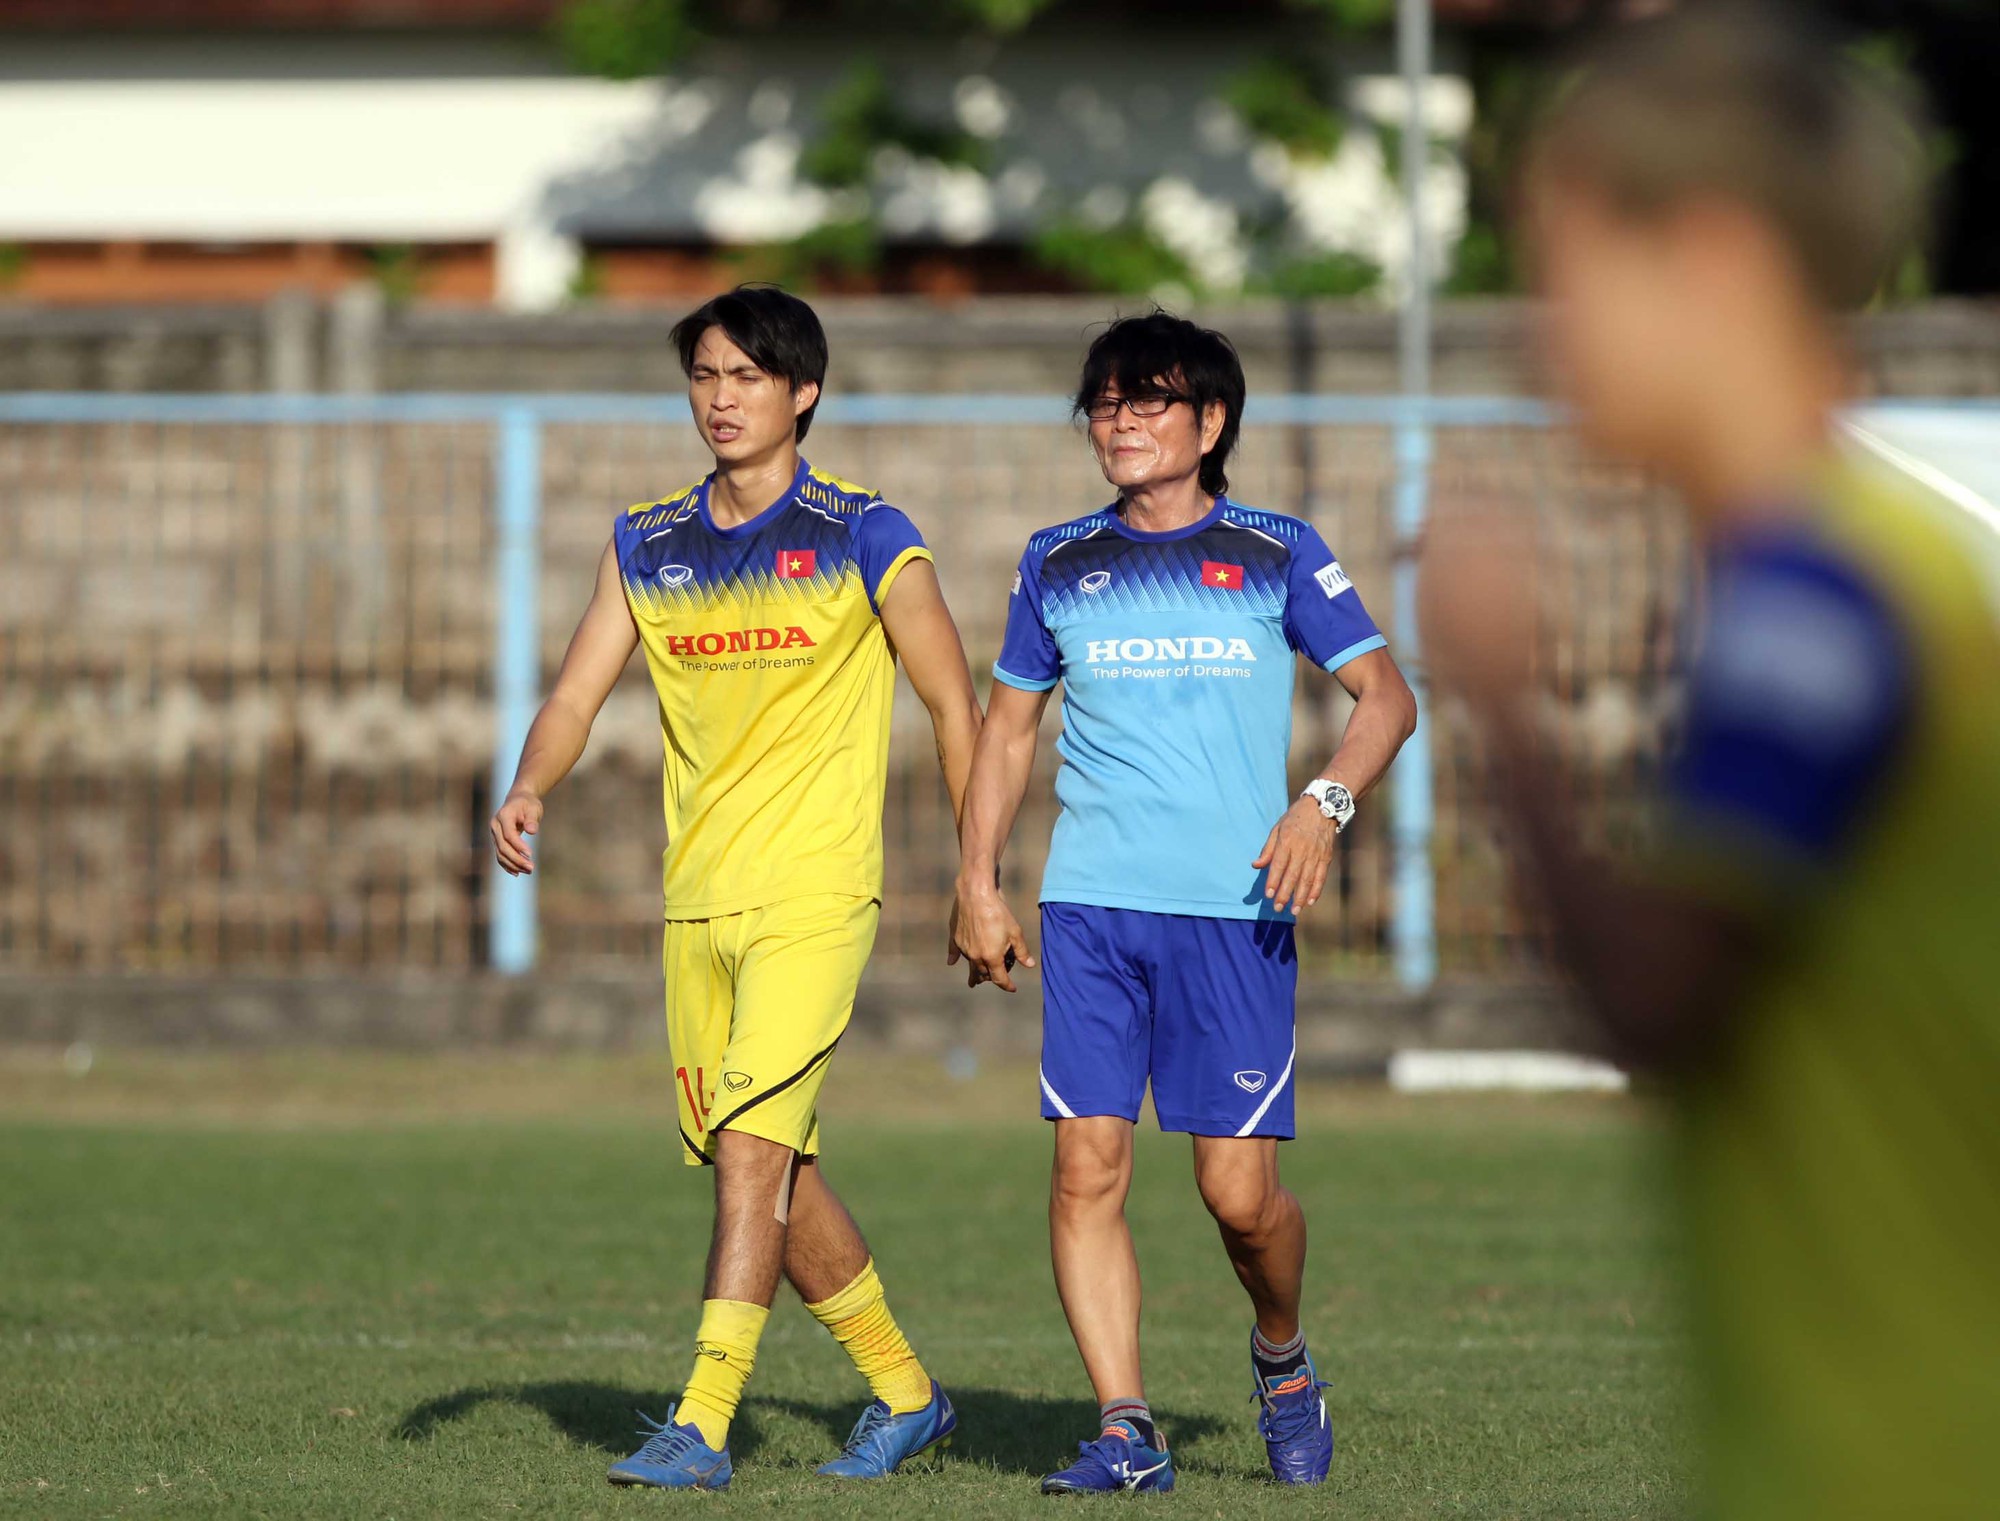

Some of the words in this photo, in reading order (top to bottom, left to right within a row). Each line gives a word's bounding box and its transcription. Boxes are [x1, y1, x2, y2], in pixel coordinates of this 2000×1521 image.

[666, 626, 817, 656] HONDA
[1085, 636, 1257, 663] HONDA
[679, 660, 702, 671] The
[704, 661, 741, 672] Power
[743, 658, 757, 670] of
[760, 656, 815, 669] Dreams
[1091, 667, 1119, 679] The
[1122, 666, 1171, 678] Power
[1174, 665, 1190, 677] of
[1194, 665, 1252, 678] Dreams
